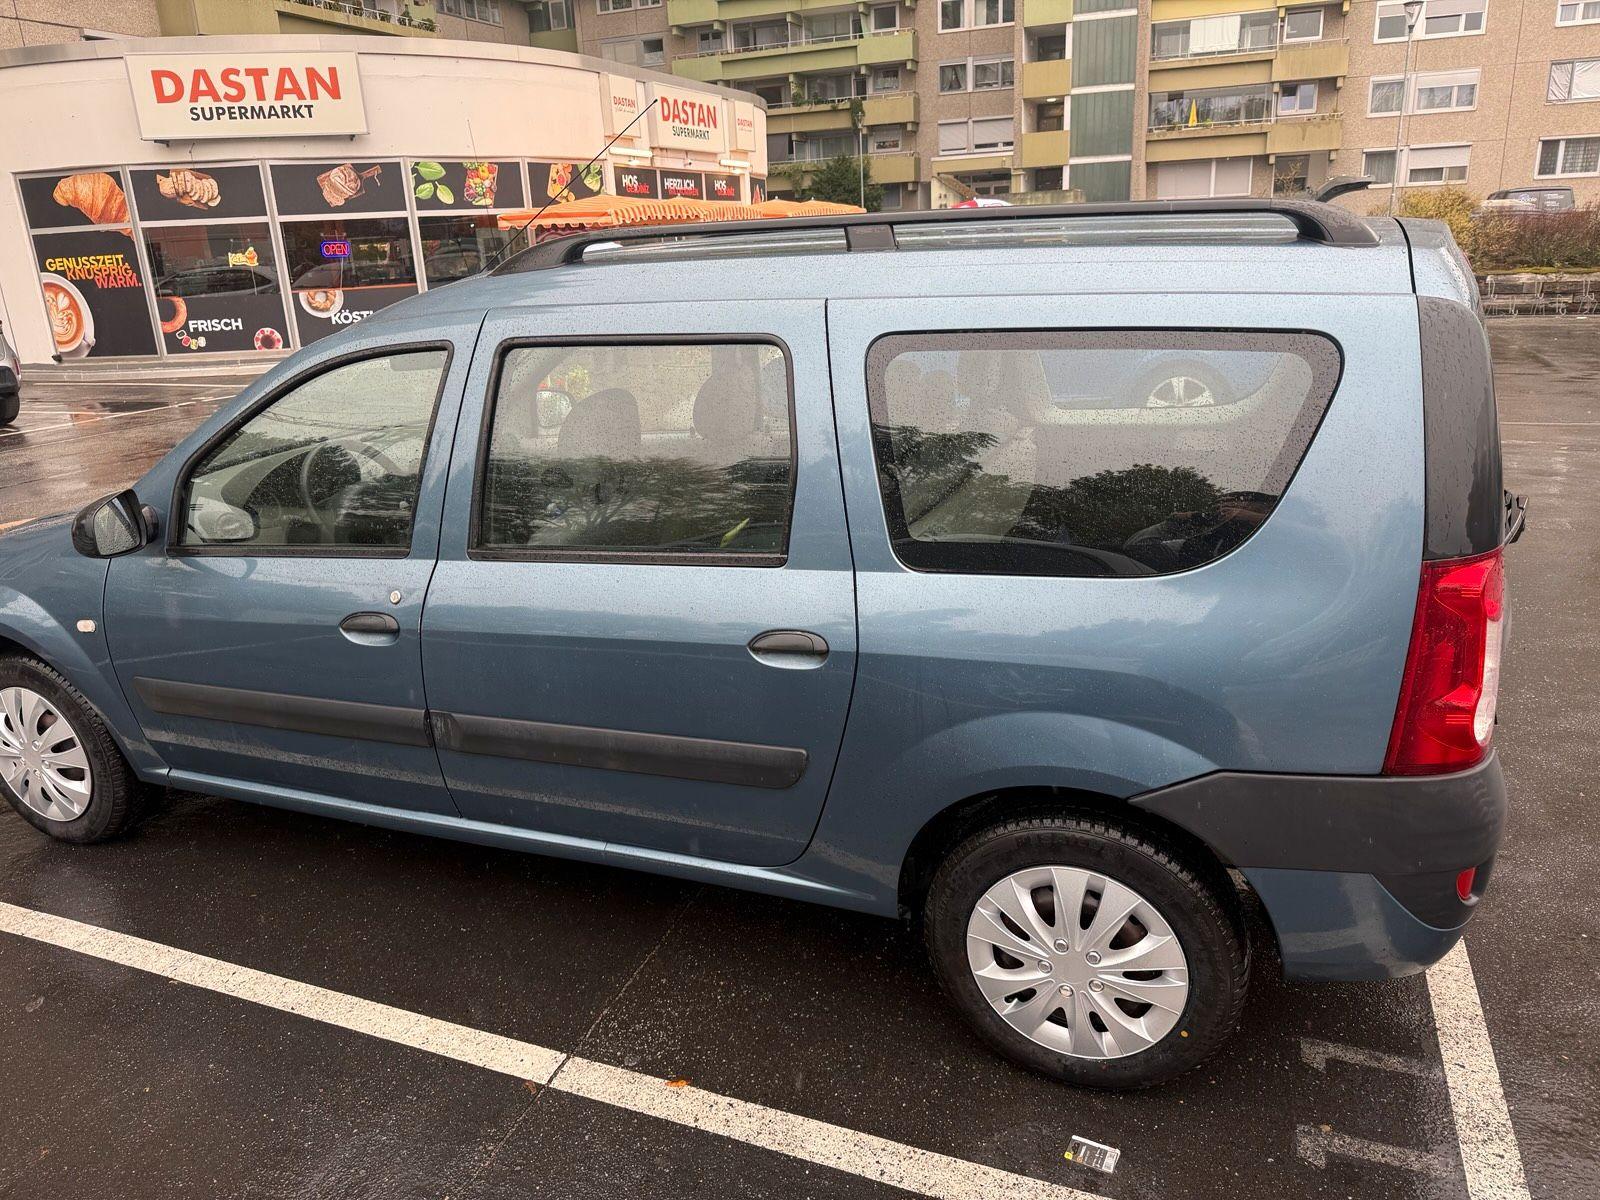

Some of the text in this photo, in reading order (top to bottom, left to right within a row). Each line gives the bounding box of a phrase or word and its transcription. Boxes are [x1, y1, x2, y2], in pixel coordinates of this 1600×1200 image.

[151, 67, 341, 104] DASTAN
[613, 96, 636, 108] DASTAN
[189, 105, 314, 121] SUPERMARKT
[660, 96, 718, 129] DASTAN
[672, 125, 710, 140] SUPERMARKT
[664, 177, 695, 191] HERZLICH
[323, 244, 348, 255] OPEN
[45, 254, 129, 271] GENUSSZEIT.
[94, 274, 143, 289] WARM.
[331, 309, 374, 324] KÖST
[188, 318, 244, 332] FRISCH
